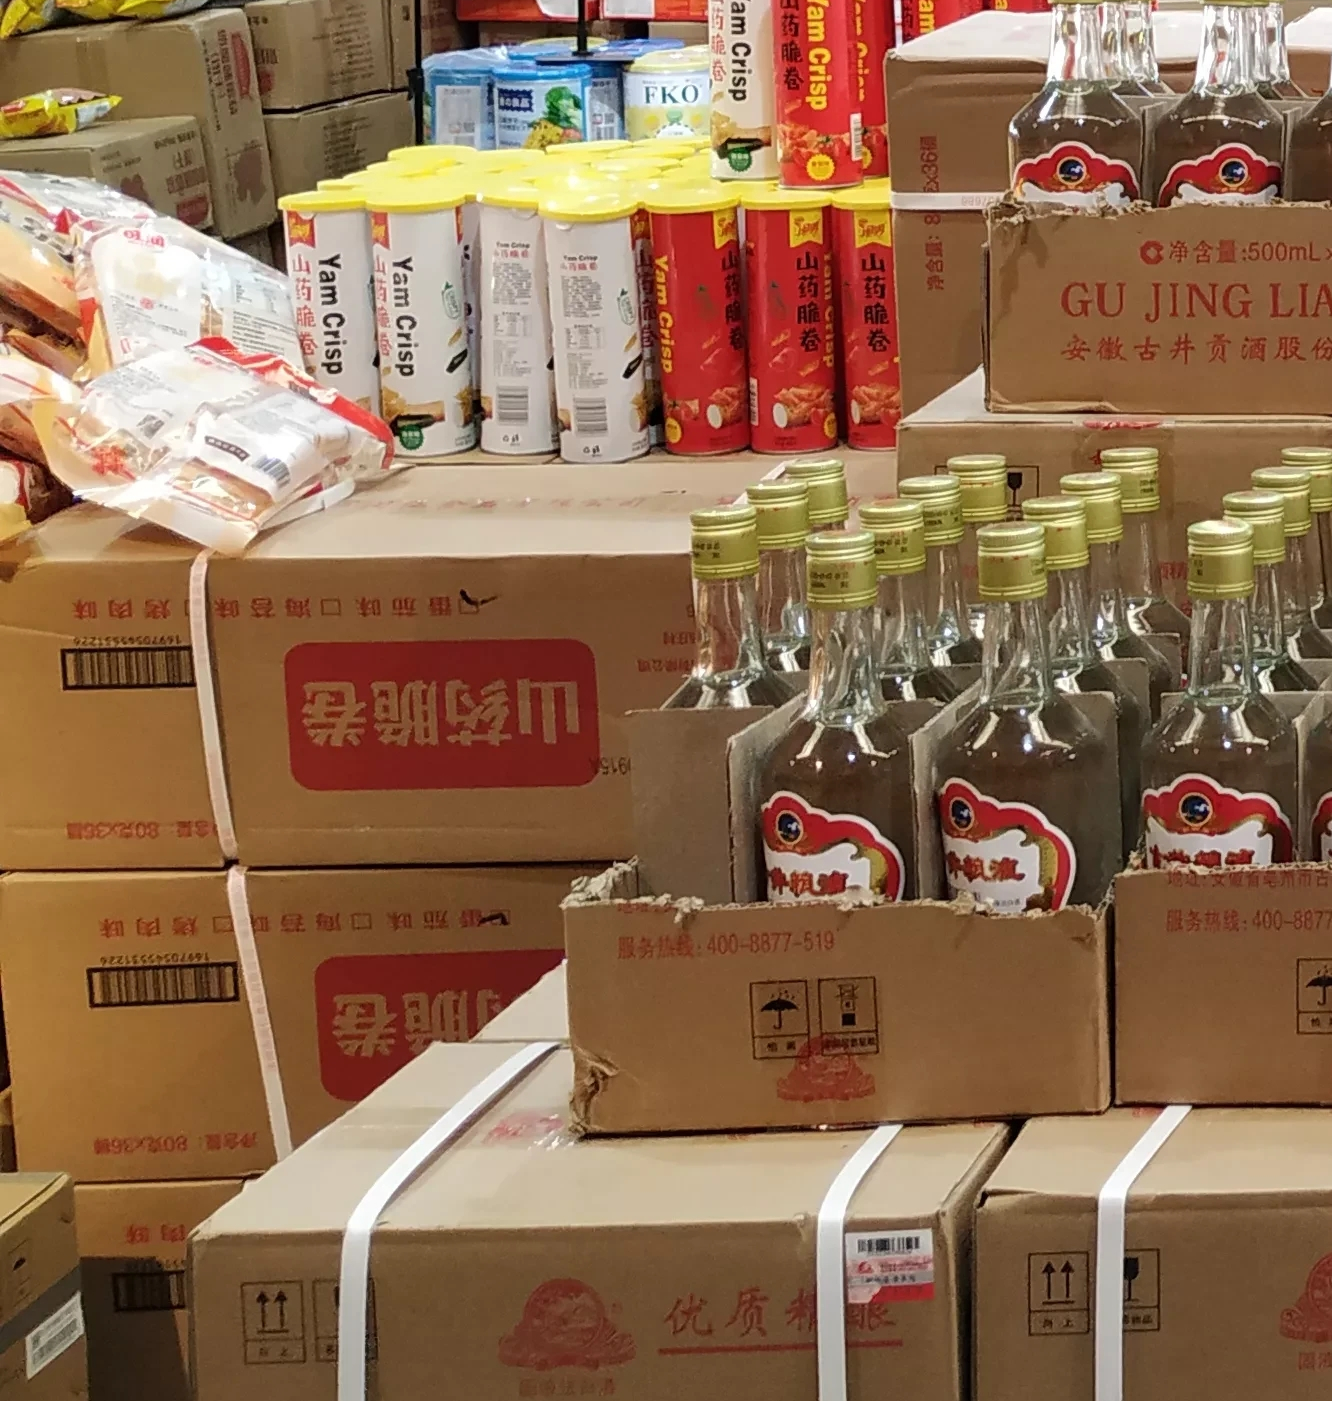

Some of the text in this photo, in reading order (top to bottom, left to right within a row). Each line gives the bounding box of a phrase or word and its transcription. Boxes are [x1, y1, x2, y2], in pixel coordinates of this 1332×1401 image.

[728, 41, 752, 103] Crisp
[805, 47, 833, 111] Crisp
[291, 253, 319, 357] 山药脆卷
[318, 252, 347, 376] Yam Crisp
[391, 255, 419, 378] Yam Crisp
[653, 253, 675, 374] Yam Crisp
[796, 252, 822, 353] 山药脆卷
[860, 252, 891, 353] 山药脆卷
[1060, 281, 1126, 319] GU
[1144, 282, 1253, 323] JING
[72, 595, 456, 620] 番茄味 海苔味 烤肉味
[302, 678, 580, 748] 山药脆卷
[98, 915, 198, 941] 烤肉味
